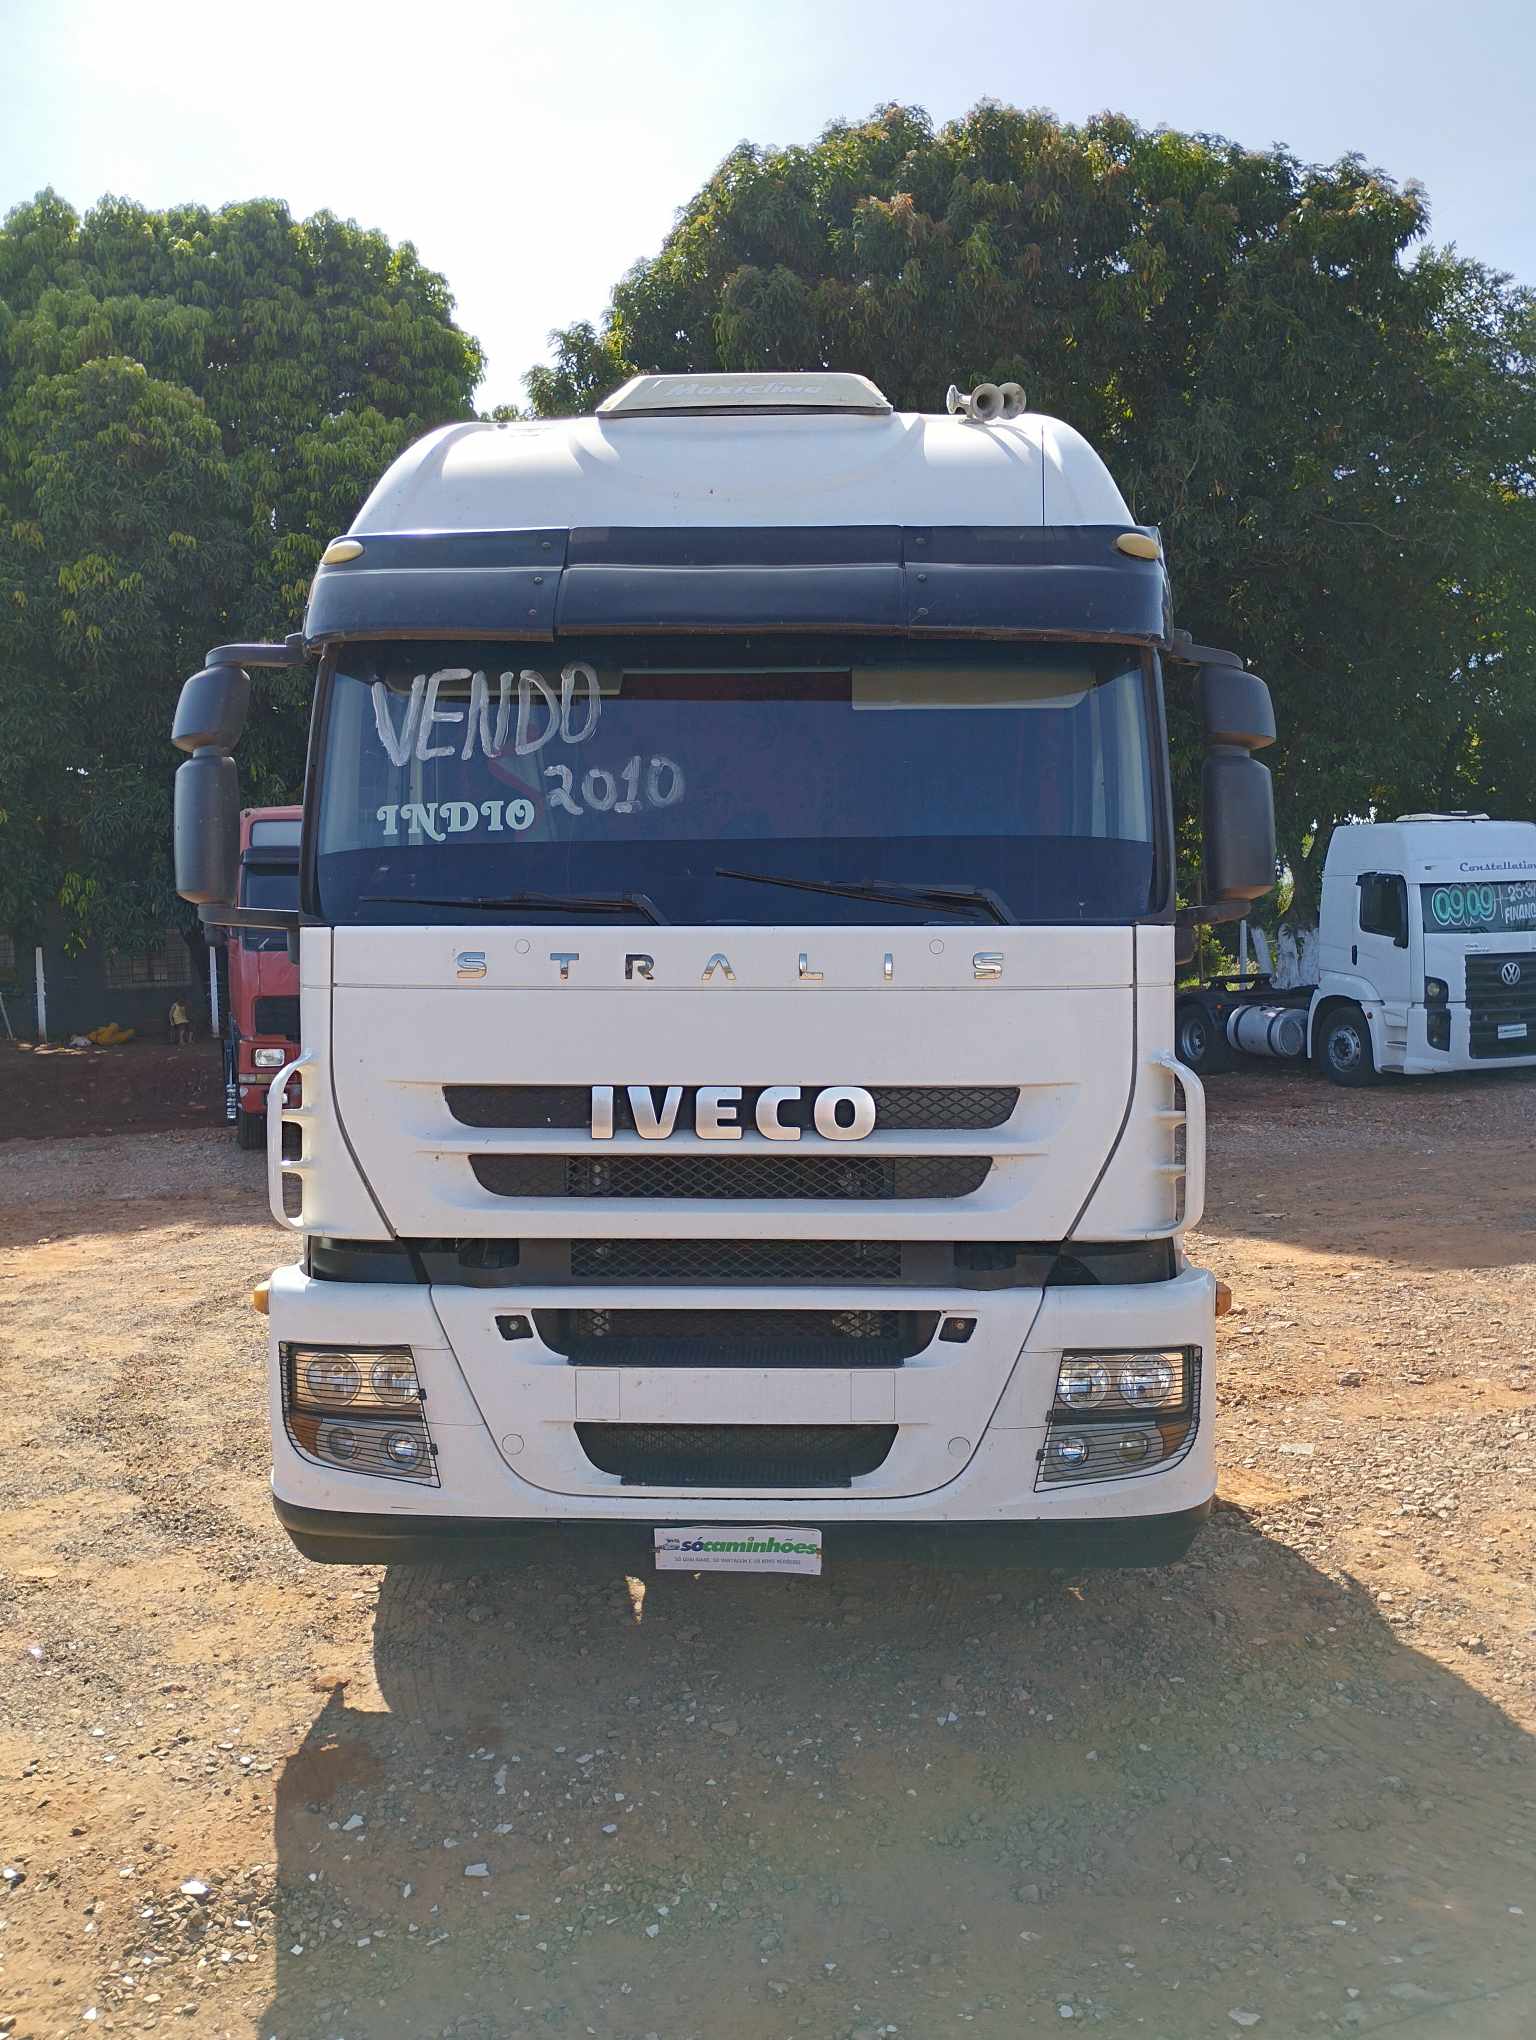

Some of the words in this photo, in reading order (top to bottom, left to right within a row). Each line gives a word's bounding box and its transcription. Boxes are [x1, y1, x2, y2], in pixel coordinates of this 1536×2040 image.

[371, 661, 602, 767] VENDO
[543, 754, 686, 815] 2010
[376, 799, 535, 842] INDIO
[456, 952, 1004, 981] STRALIS
[591, 1085, 876, 1140] IVECO
